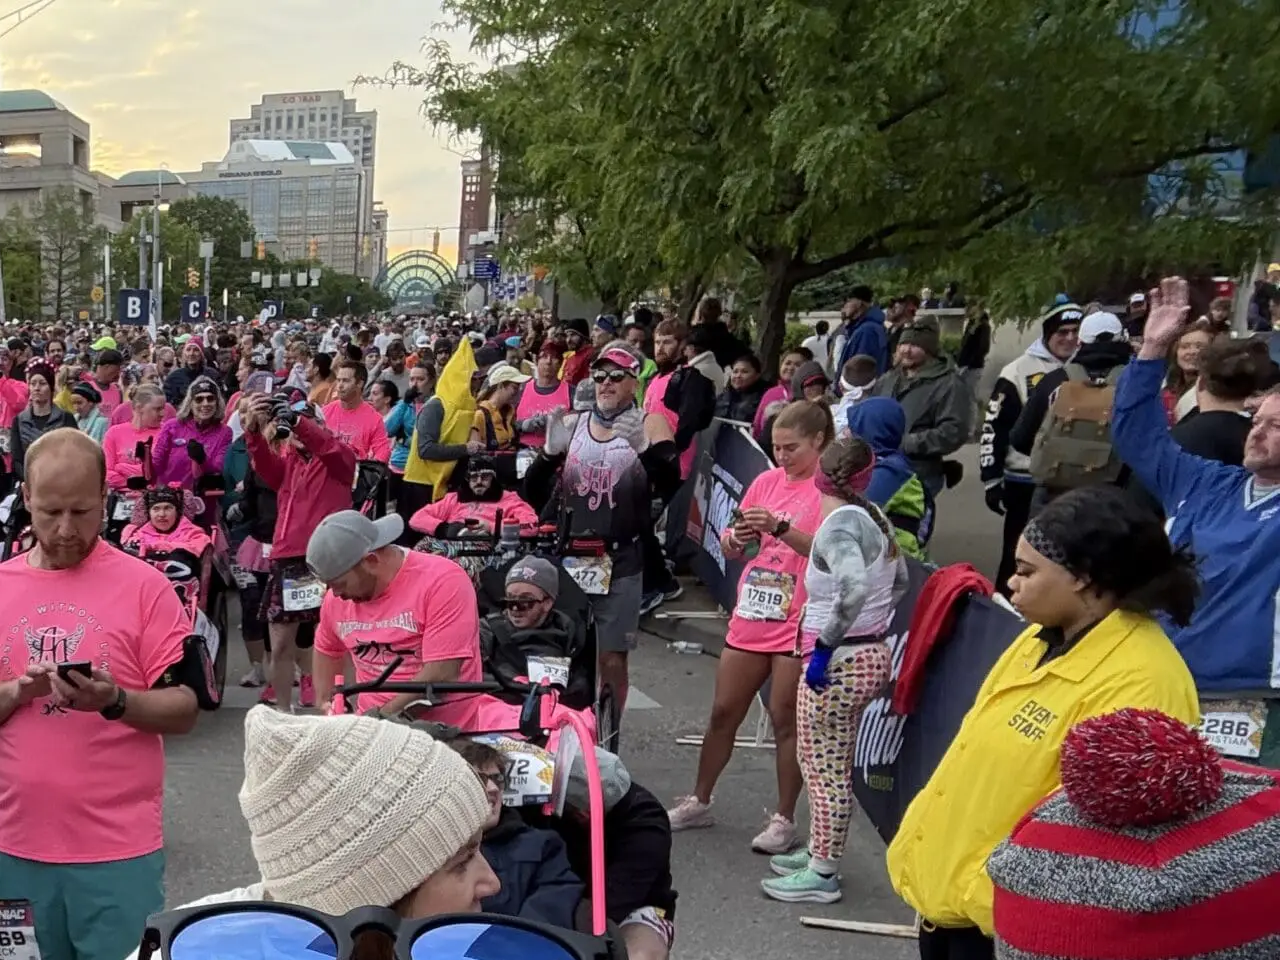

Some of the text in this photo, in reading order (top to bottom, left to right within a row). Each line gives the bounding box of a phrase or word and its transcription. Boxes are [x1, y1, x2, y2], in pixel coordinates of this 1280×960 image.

[127, 296, 141, 318] B
[188, 301, 200, 318] C
[269, 304, 278, 317] D
[311, 304, 318, 317] E
[291, 587, 319, 600] 8024
[747, 588, 783, 606] 17619
[1020, 699, 1058, 729] EVENT
[1008, 714, 1046, 742] STAFF
[511, 775, 528, 785] TIN
